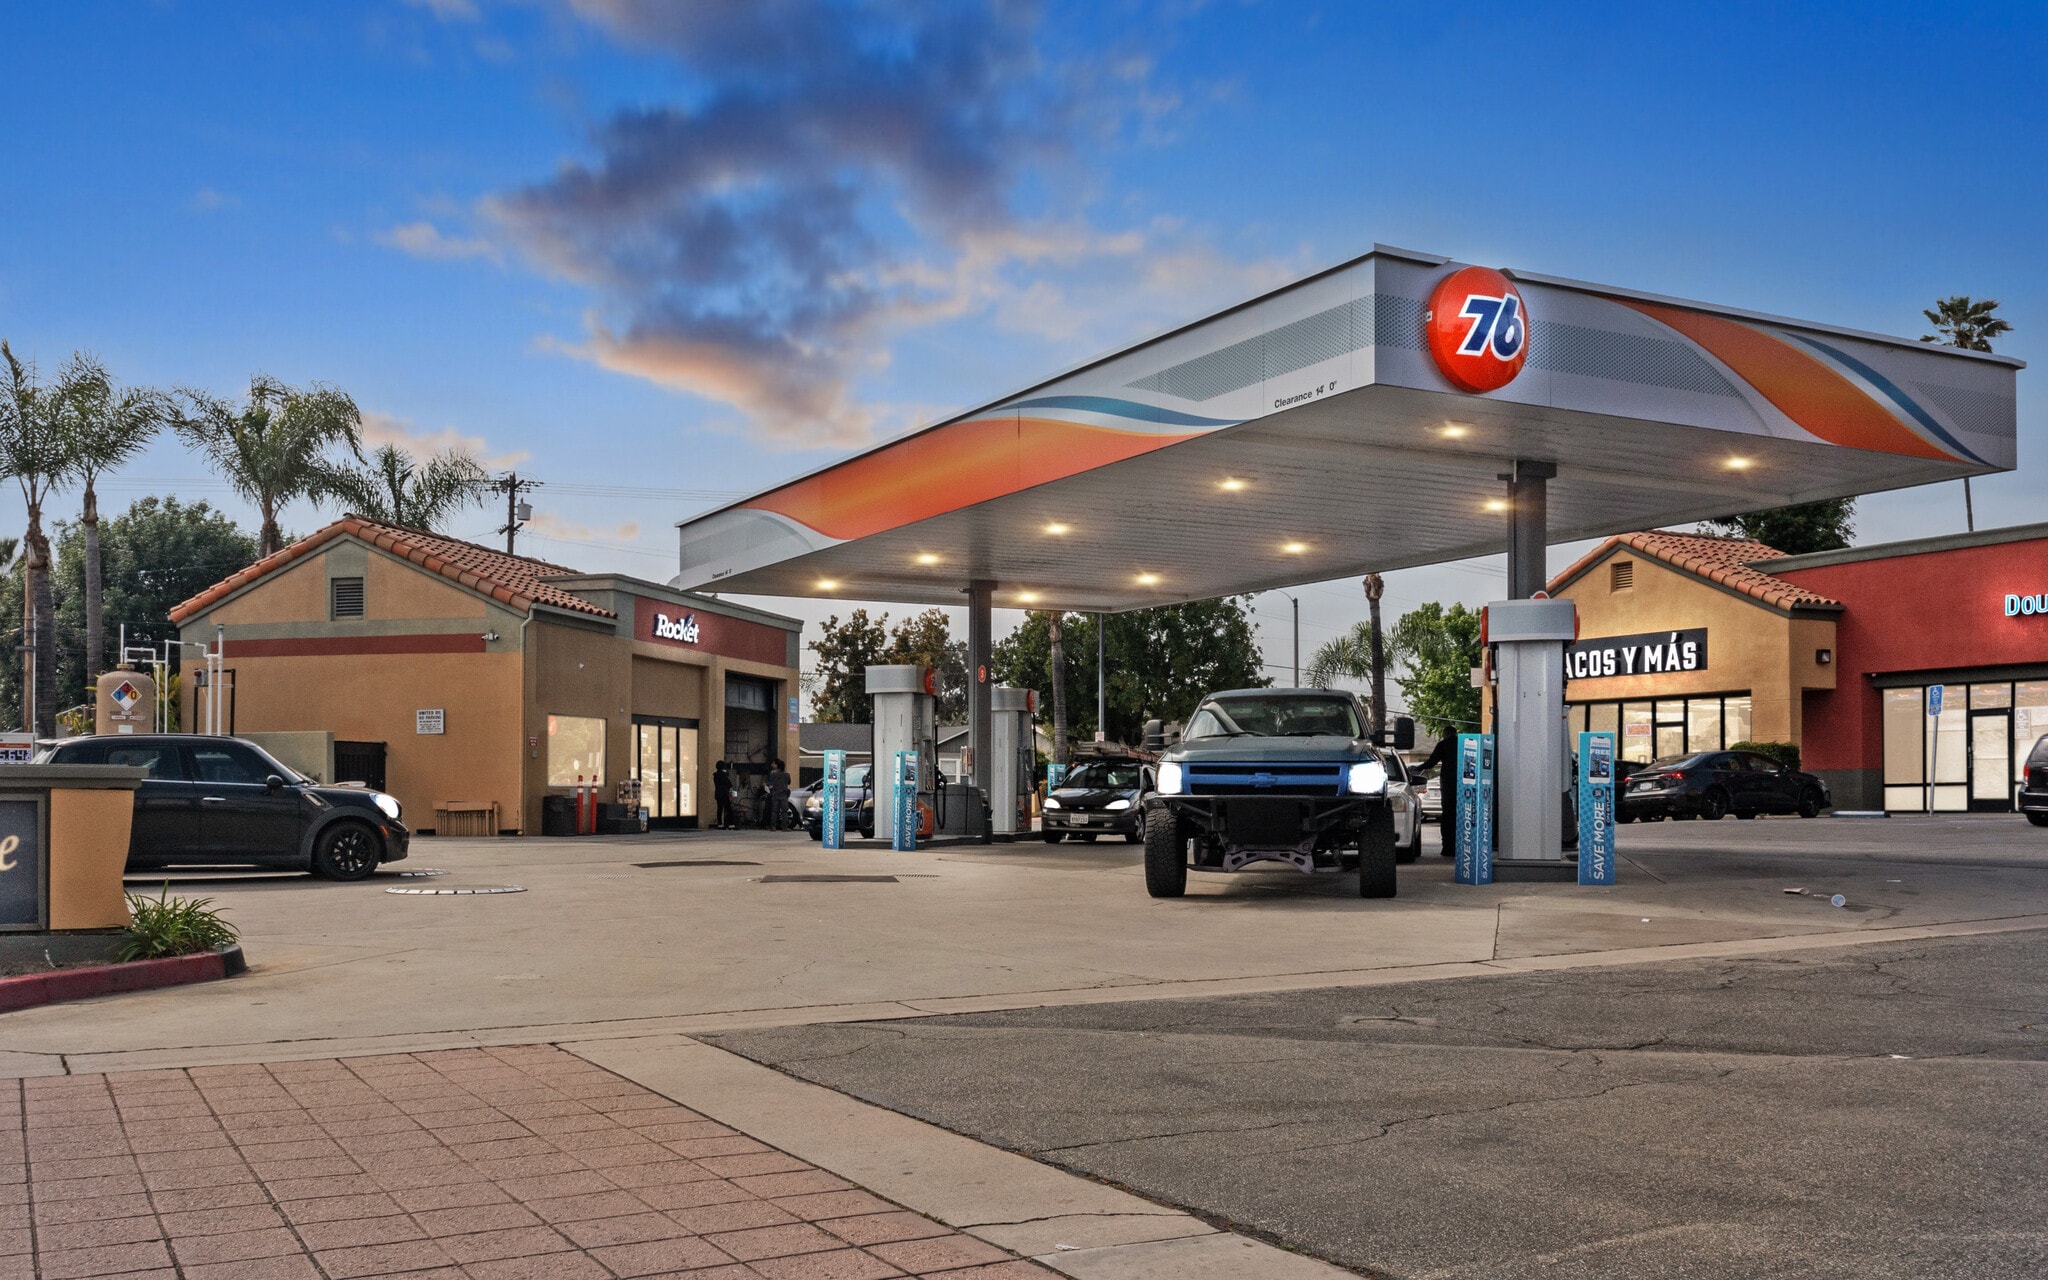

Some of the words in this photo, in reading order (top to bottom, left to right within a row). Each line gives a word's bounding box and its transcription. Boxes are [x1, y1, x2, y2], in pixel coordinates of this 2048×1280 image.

[1456, 292, 1525, 362] 76
[1274, 391, 1313, 408] Clearance
[653, 613, 700, 644] Rocket
[1622, 646, 1637, 674] Y
[1644, 631, 1697, 673] MÁS
[131, 690, 137, 700] 0
[1464, 802, 1472, 842] MORE
[1593, 801, 1605, 843] MORE
[1463, 845, 1471, 879] SAVE
[1593, 845, 1605, 880] SAVE
